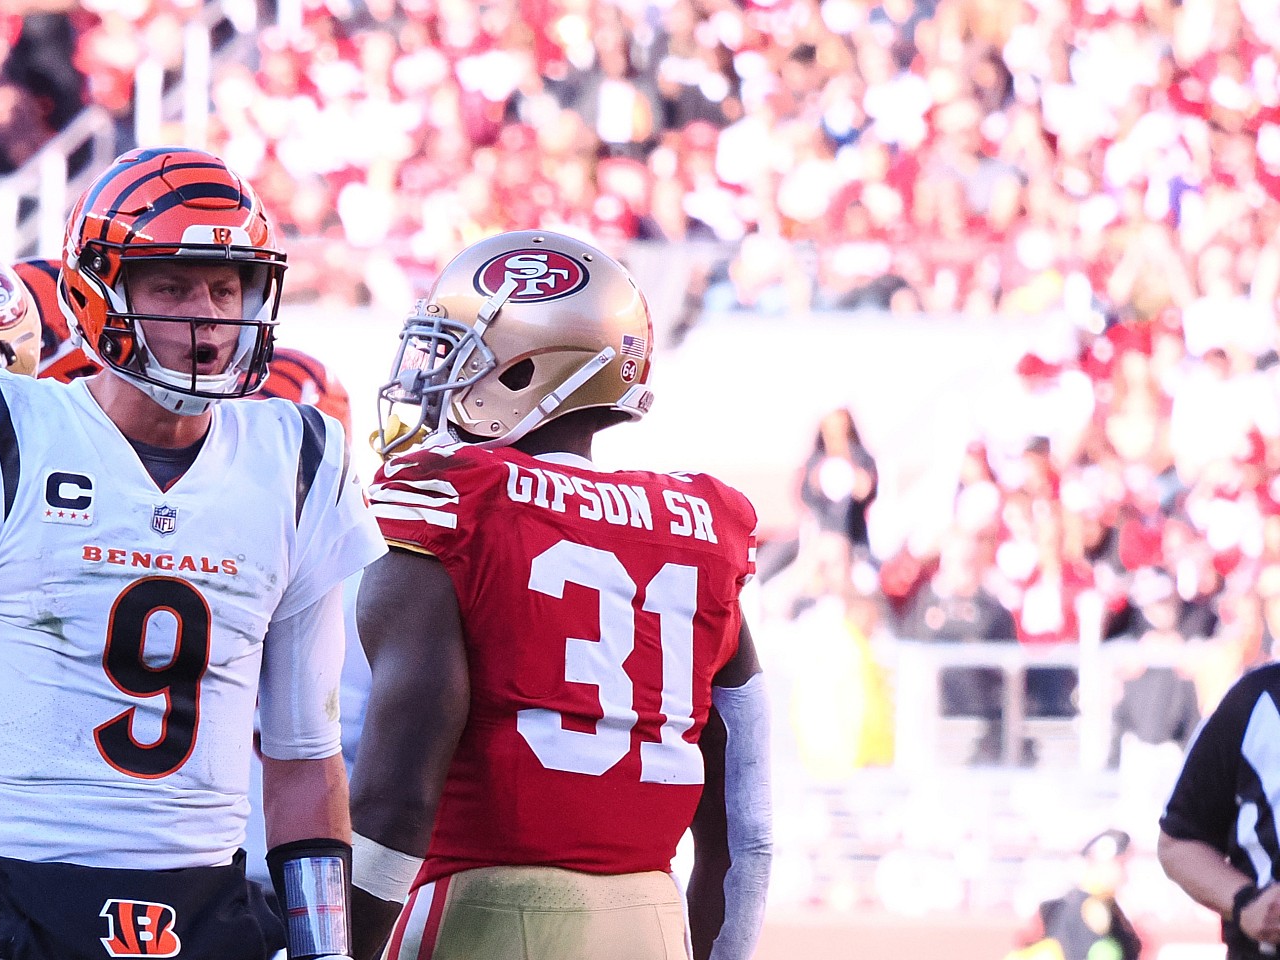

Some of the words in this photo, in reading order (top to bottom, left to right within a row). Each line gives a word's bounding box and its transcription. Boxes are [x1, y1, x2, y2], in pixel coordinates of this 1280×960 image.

[212, 227, 232, 245] B
[505, 254, 569, 295] SF
[622, 363, 636, 379] 64
[45, 472, 93, 510] C
[504, 461, 653, 531] GIPSON
[662, 488, 718, 544] SR
[82, 545, 239, 576] BENGALS
[93, 576, 211, 779] 9
[516, 538, 705, 785] 31
[99, 898, 182, 959] B
